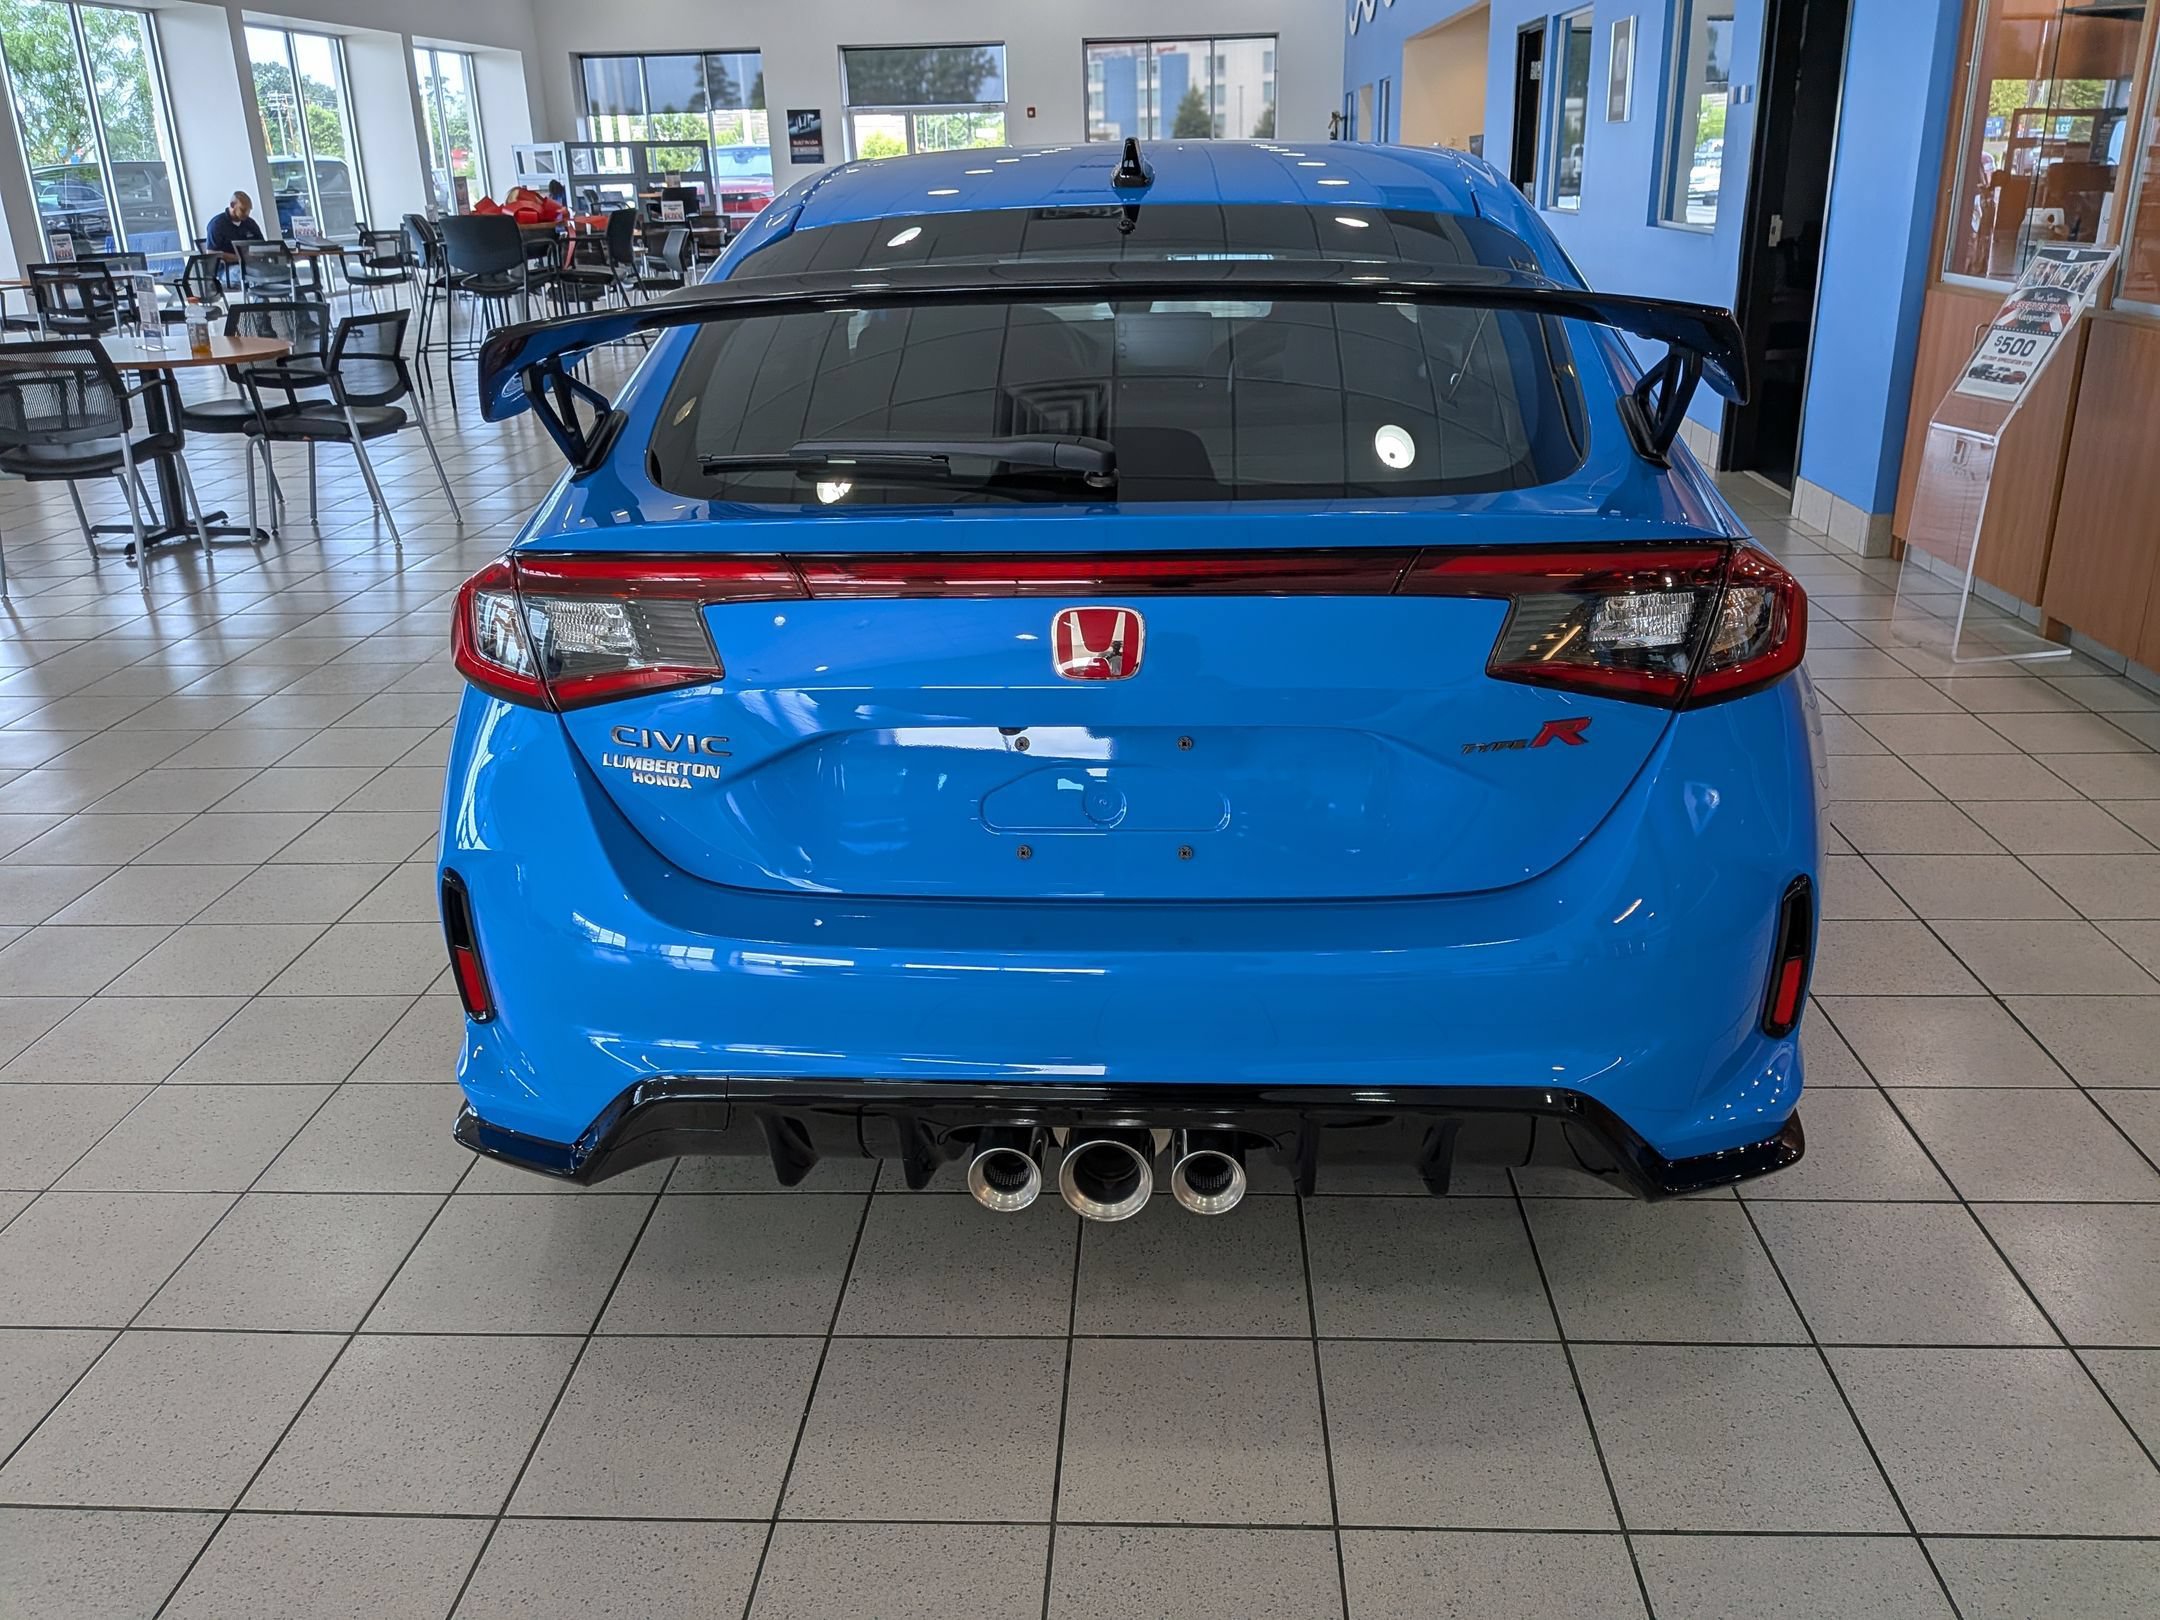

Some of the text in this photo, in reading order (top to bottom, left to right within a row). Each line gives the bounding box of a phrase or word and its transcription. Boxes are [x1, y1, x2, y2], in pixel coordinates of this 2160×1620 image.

[1994, 335, 2037, 357] $500
[610, 725, 732, 757] CIVIC
[1461, 716, 1593, 754] TYPE R
[602, 753, 721, 779] LUMBERTON
[631, 771, 692, 789] HONDA
